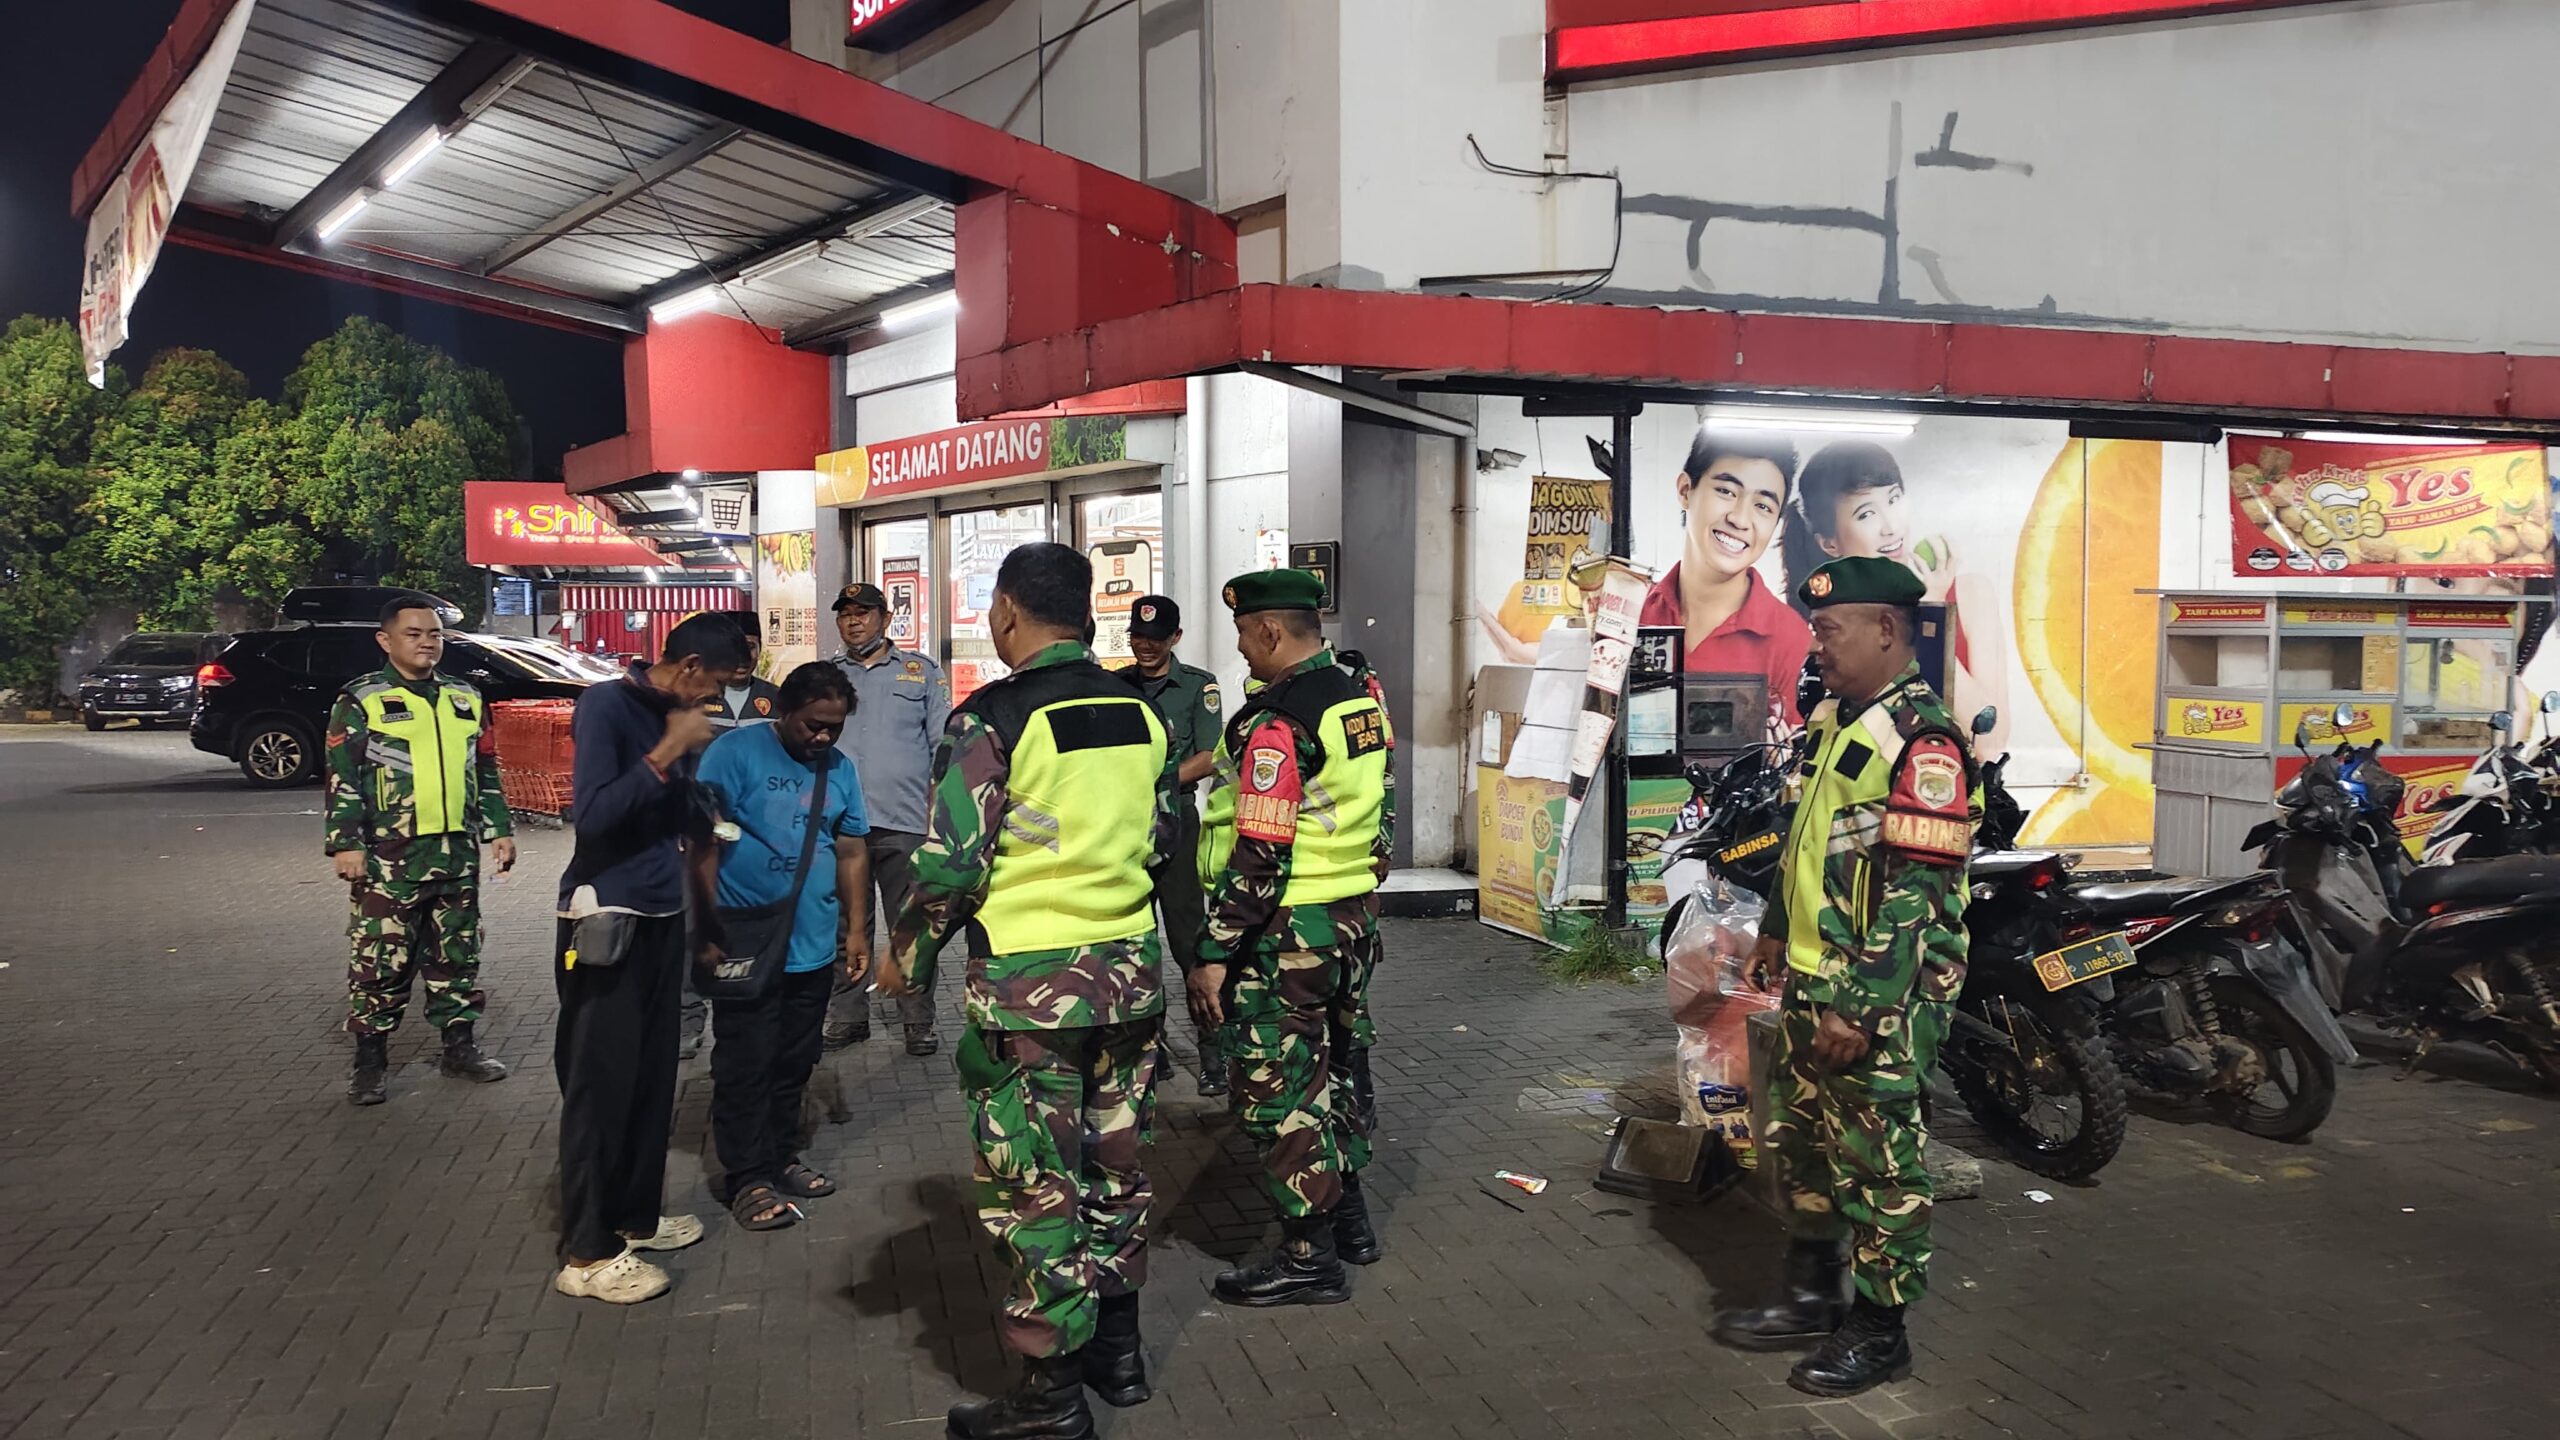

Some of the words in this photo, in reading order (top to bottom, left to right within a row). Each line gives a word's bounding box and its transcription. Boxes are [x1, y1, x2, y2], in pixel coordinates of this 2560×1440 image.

[872, 440, 950, 486] SELAMAT
[956, 422, 1042, 472] DATANG
[2383, 467, 2473, 509] Yes
[2418, 508, 2452, 523] JAMAN
[2453, 501, 2478, 514] NOW
[890, 624, 912, 638] INDO
[893, 616, 910, 624] SUPER
[2213, 705, 2245, 722] Yes
[767, 776, 804, 793] SKY
[1884, 812, 1970, 856] BABINS
[1720, 832, 1779, 864] BABINSA
